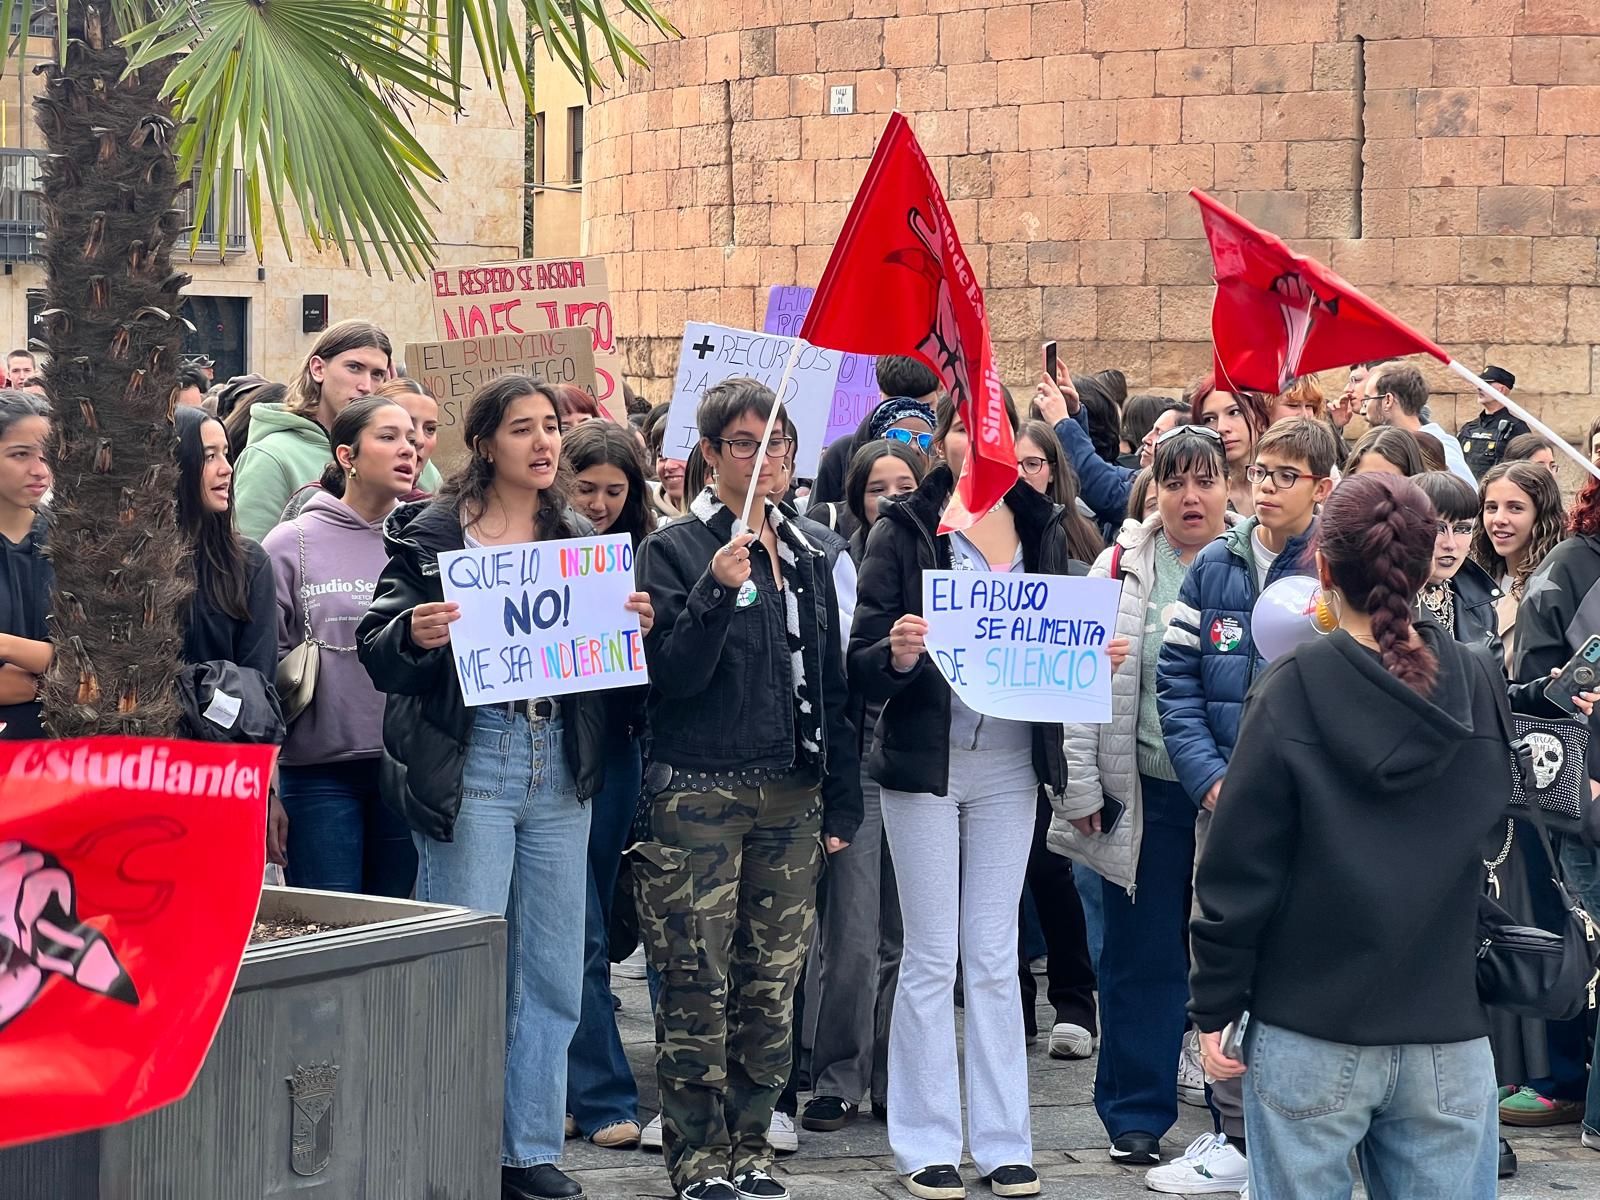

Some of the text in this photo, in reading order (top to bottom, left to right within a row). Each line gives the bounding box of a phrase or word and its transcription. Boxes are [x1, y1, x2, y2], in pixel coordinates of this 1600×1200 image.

[433, 271, 457, 297] EL
[458, 267, 515, 296] RESPETO
[516, 266, 534, 291] SE
[777, 286, 815, 312] HO
[952, 257, 971, 286] de
[965, 280, 985, 320] Es
[423, 332, 568, 371] EL BULLYING
[715, 334, 833, 372] RECURSOS
[423, 375, 446, 399] NO
[450, 370, 475, 397] ES
[448, 543, 633, 590] QUE LO INJUSTO
[300, 578, 353, 599] Studio
[932, 578, 1049, 612] EL ABUSO
[503, 584, 571, 637] NO!
[974, 616, 1106, 646] SE ALIMENTA
[458, 629, 644, 696] ME SEA INDIFERENTE
[936, 647, 1098, 691] DE SILENCIO
